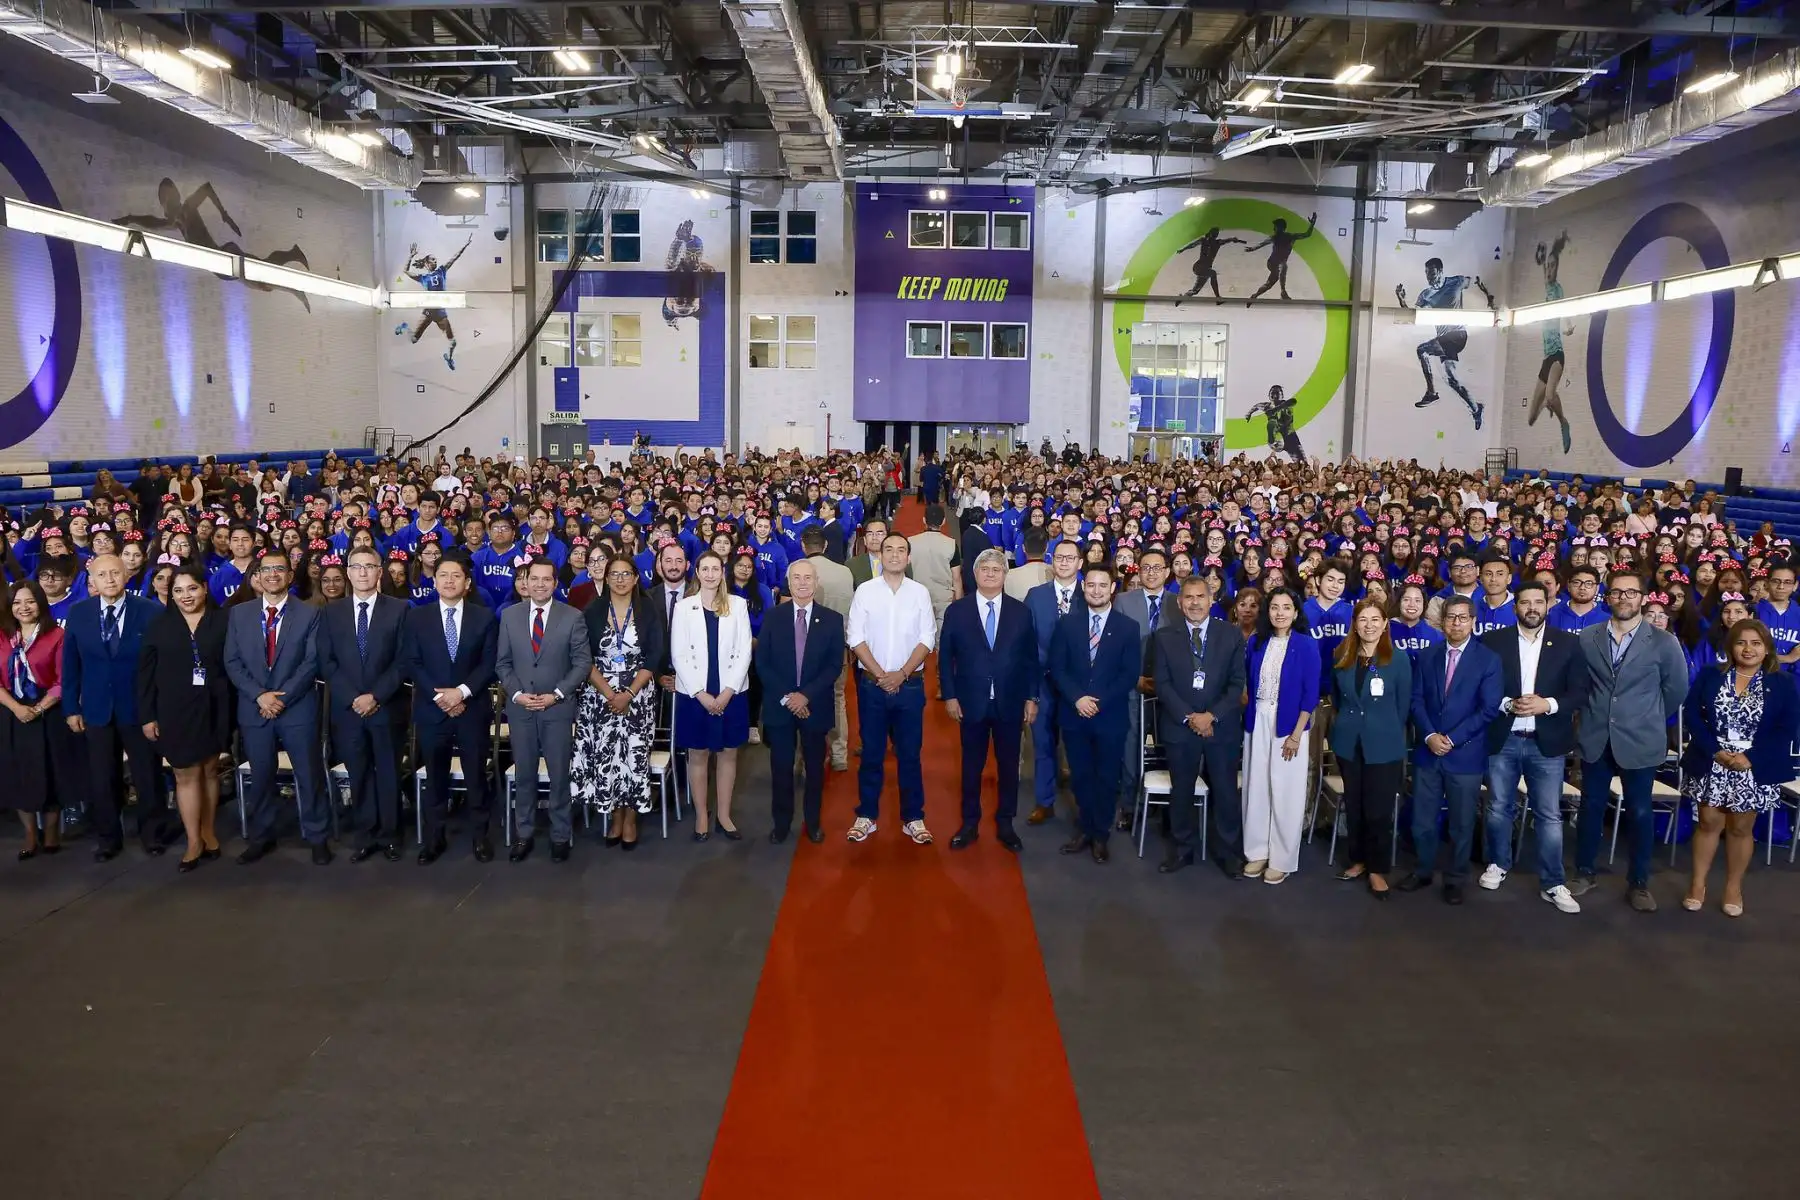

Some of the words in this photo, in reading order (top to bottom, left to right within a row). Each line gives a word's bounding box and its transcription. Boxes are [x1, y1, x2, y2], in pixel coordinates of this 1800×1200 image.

[897, 276, 942, 300] KEEP
[943, 278, 1009, 302] MOVING
[483, 564, 513, 577] USIL
[1309, 623, 1349, 640] USIL
